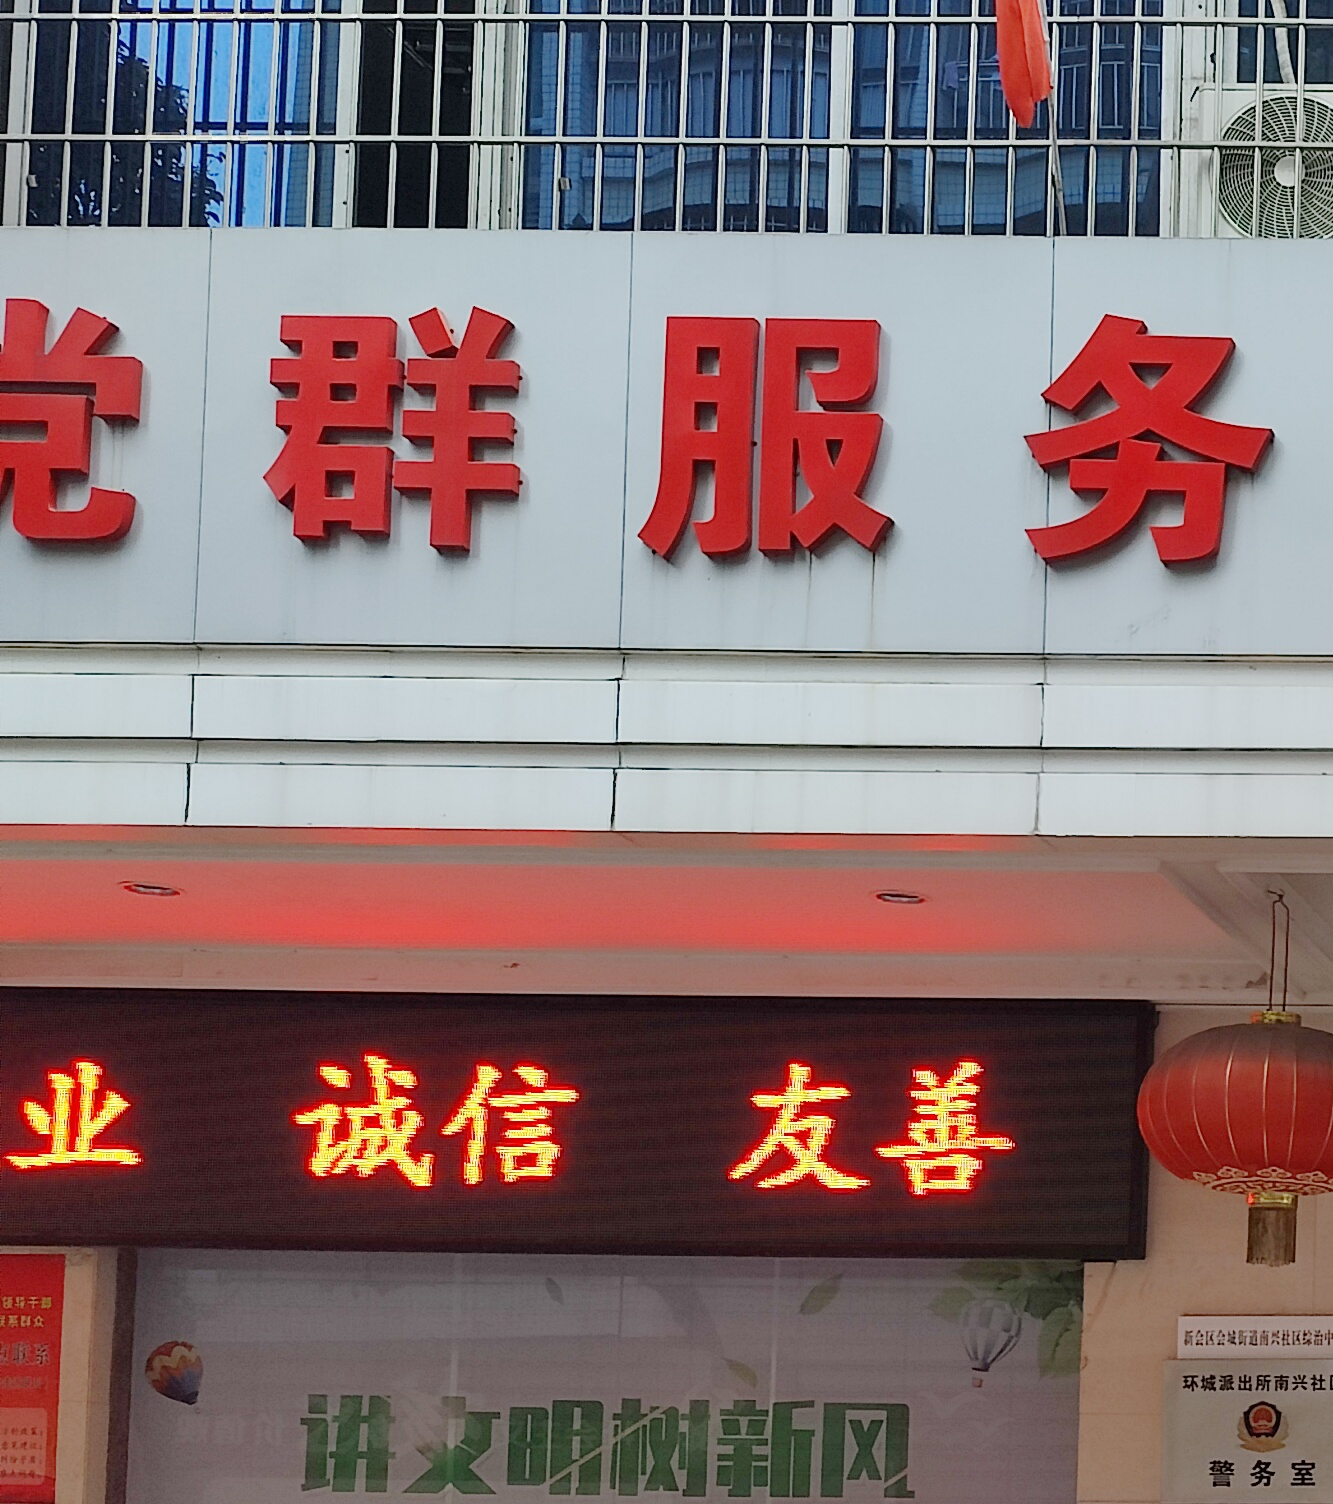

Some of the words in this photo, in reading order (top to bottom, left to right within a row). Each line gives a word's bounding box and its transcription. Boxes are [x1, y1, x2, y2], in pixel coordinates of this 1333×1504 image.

[294, 1055, 580, 1188] 诚信
[728, 1060, 1015, 1196] 友善
[300, 1393, 916, 1499] 讲文明树新风
[1209, 1460, 1316, 1487] 警务室
